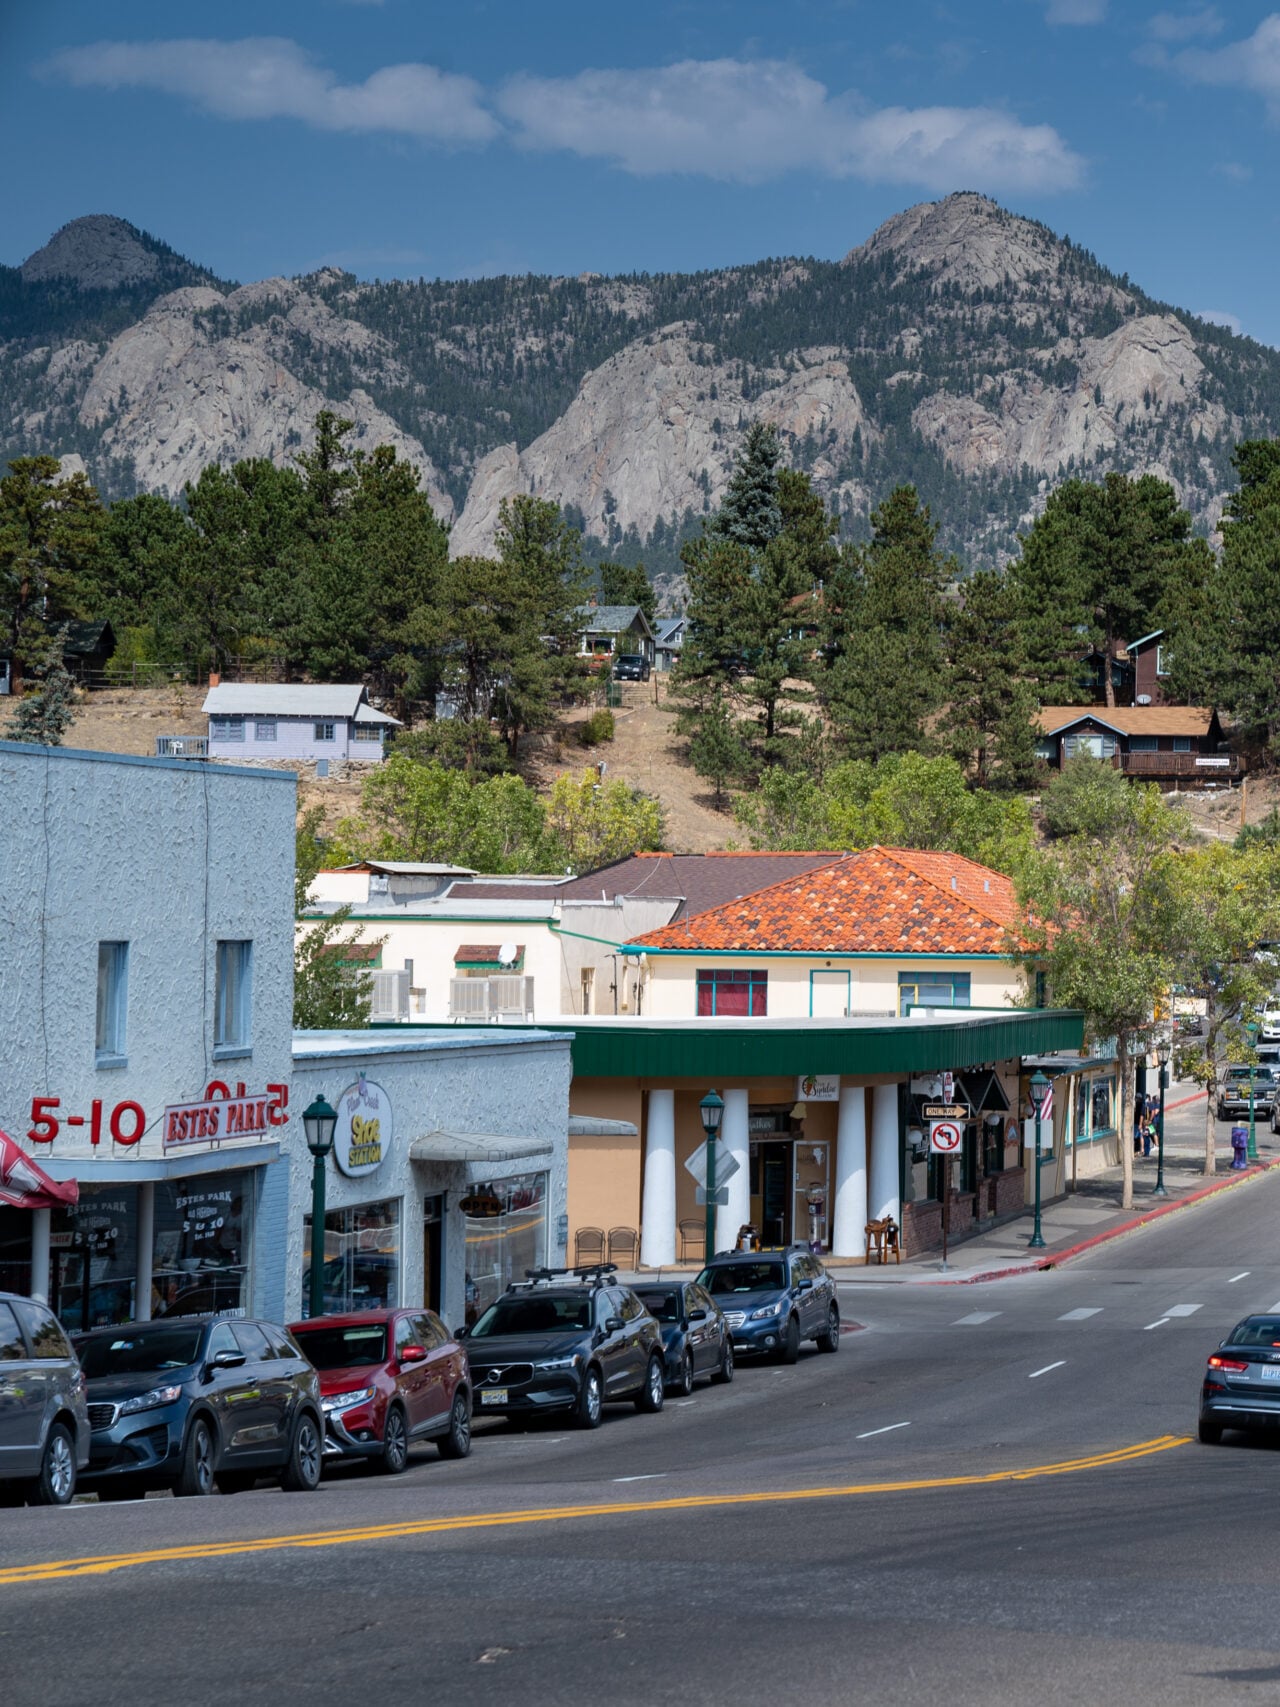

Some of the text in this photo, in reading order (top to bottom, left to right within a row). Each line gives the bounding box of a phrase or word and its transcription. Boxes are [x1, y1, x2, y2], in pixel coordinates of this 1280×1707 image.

[27, 1097, 146, 1146] 5-10
[167, 1101, 266, 1141] ESTES PARK
[351, 1114, 381, 1146] Shoe
[349, 1145, 382, 1168] STATION
[176, 1190, 232, 1209] ESTES PARK
[104, 1226, 119, 1240] 10
[183, 1220, 191, 1233] 5
[210, 1216, 224, 1229] 10
